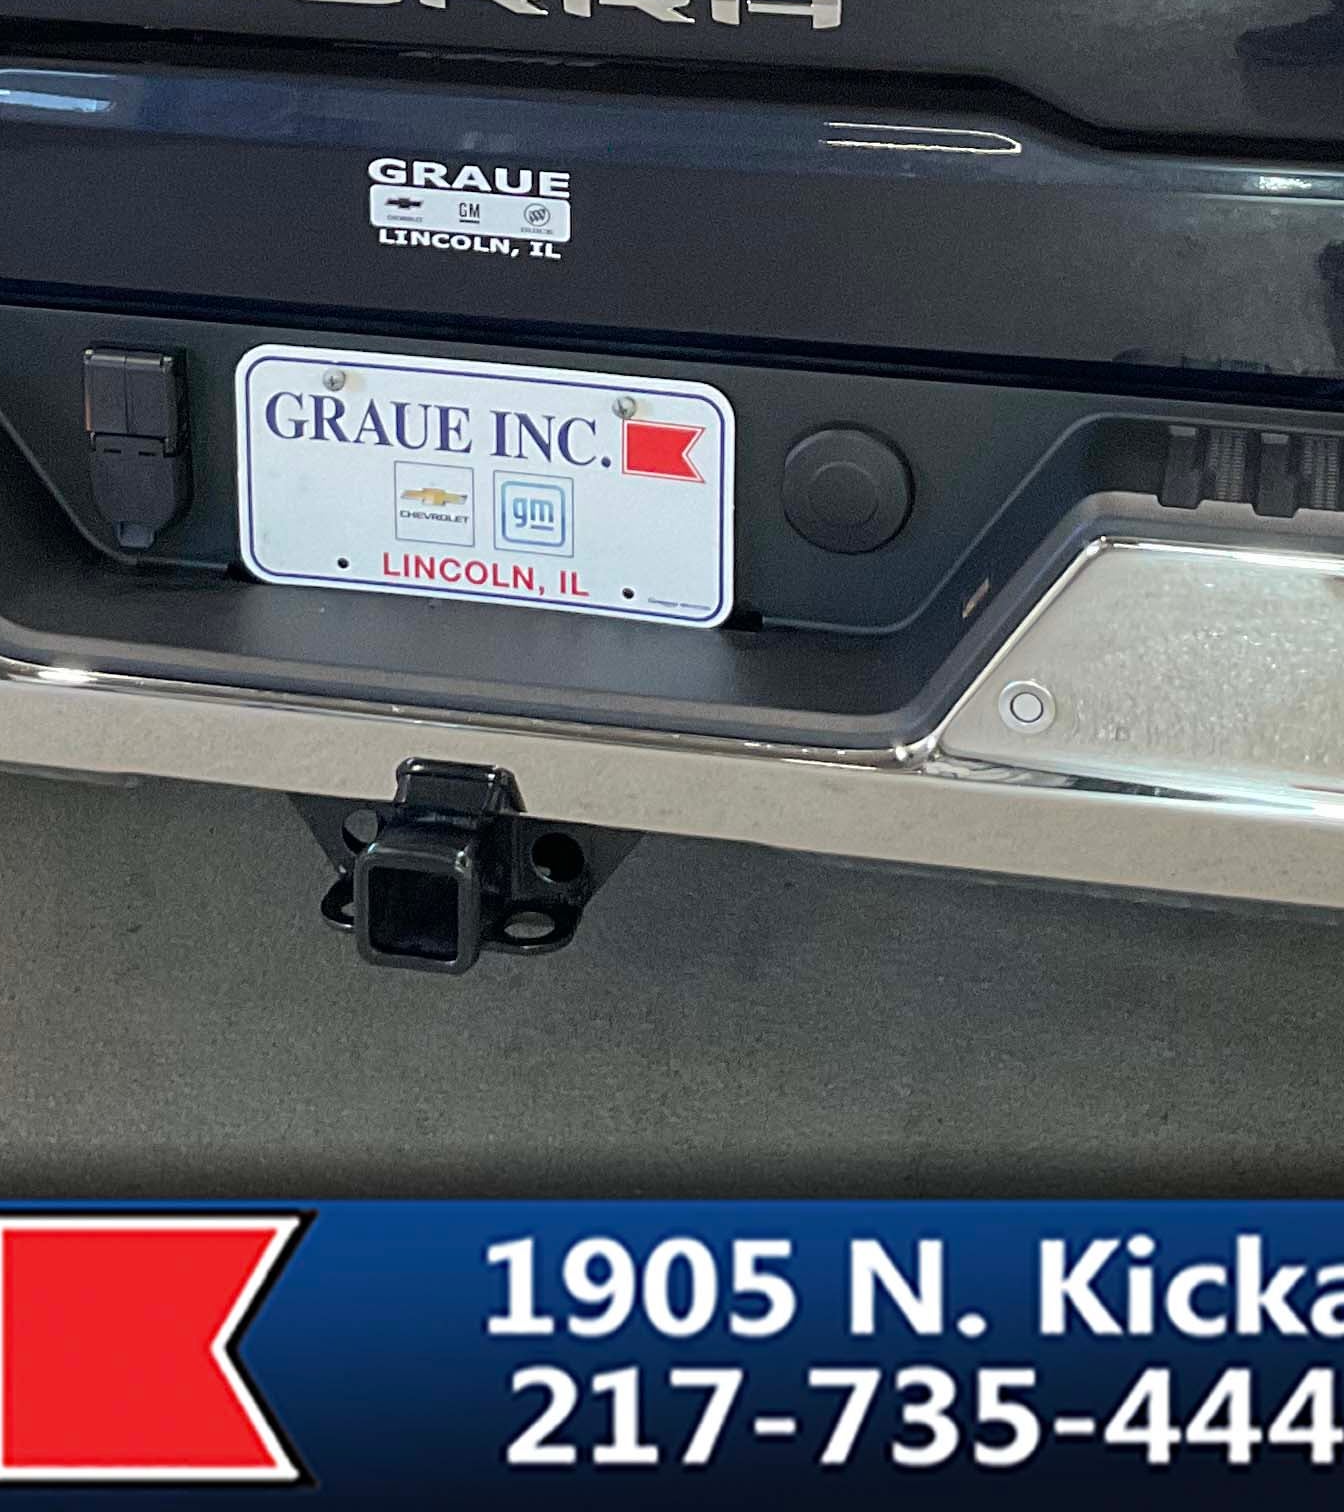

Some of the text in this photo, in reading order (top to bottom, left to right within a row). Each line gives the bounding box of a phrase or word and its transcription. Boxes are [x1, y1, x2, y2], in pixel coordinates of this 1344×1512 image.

[368, 158, 570, 198] GRAUE
[459, 202, 480, 219] GM
[379, 228, 561, 259] LINCOLN, IL
[265, 391, 612, 469] GRAUE INC.
[399, 510, 470, 524] CHEVROLET
[513, 496, 554, 529] gm
[382, 551, 590, 597] LINCOLN, IL
